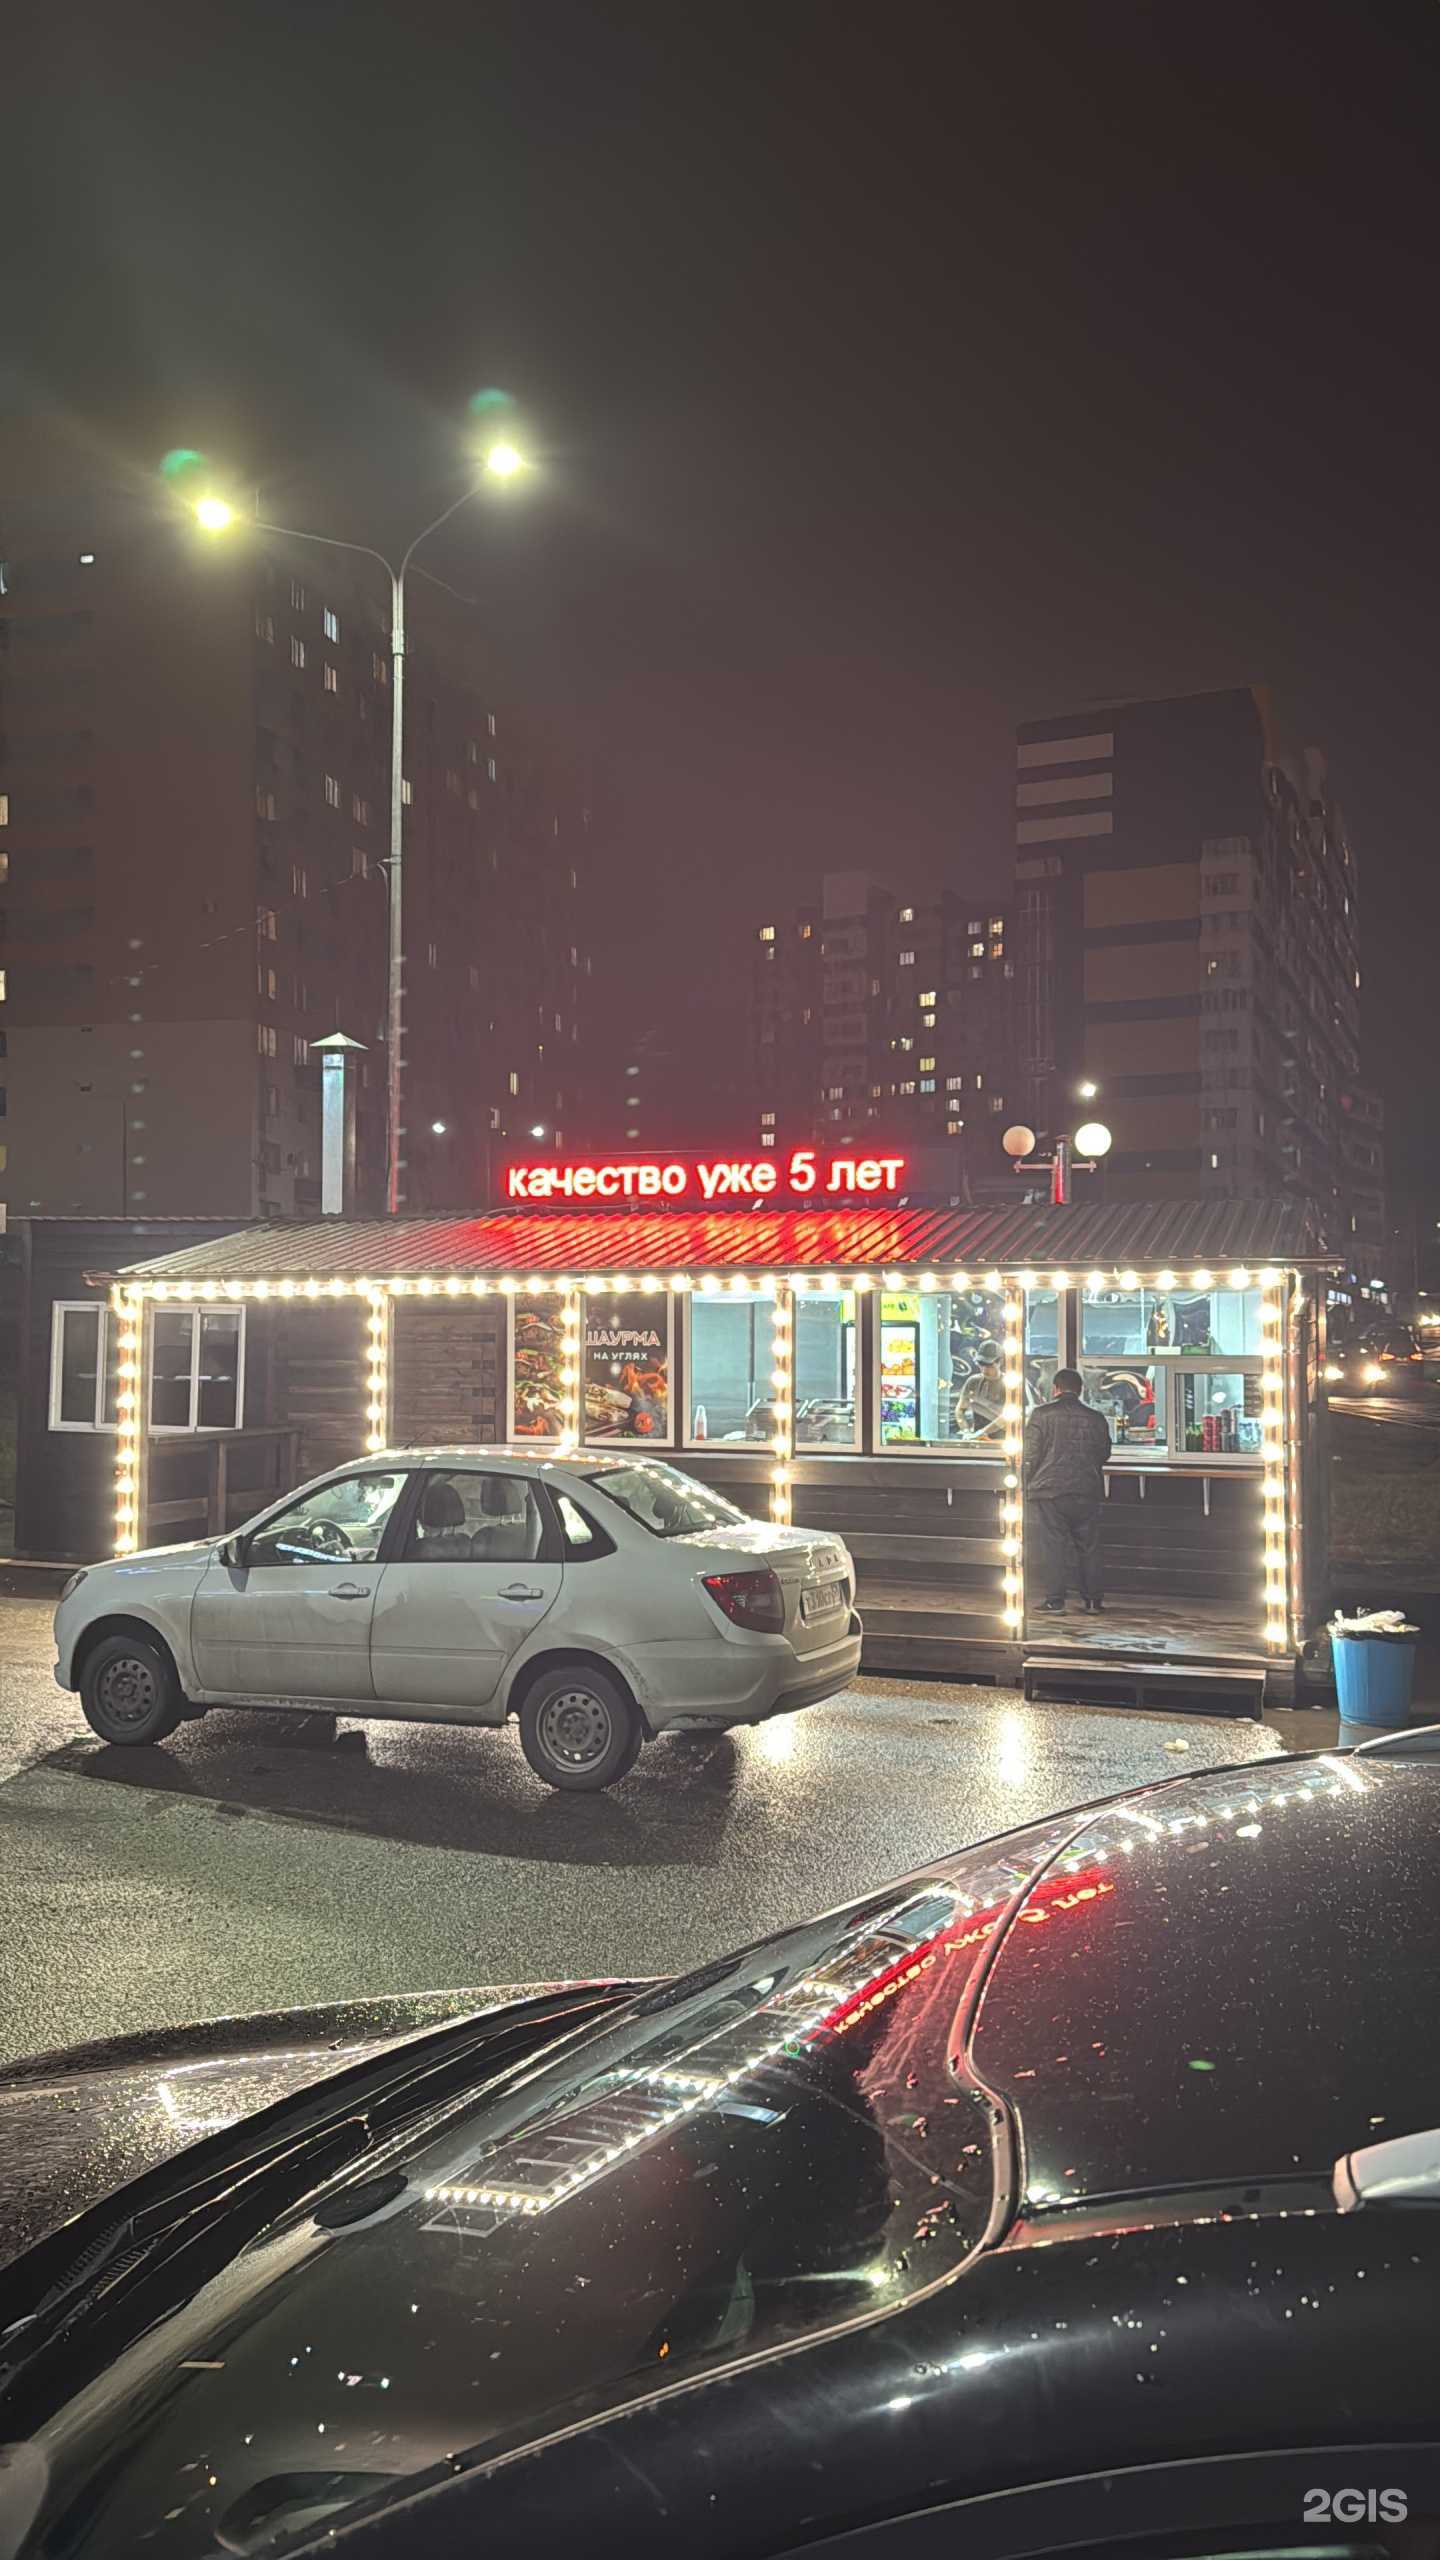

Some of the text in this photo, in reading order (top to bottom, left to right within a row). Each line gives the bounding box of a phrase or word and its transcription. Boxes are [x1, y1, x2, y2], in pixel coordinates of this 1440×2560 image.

[508, 1151, 904, 1199] качество уже 5 лет
[593, 1352, 648, 1361] НА УГЛЯХ
